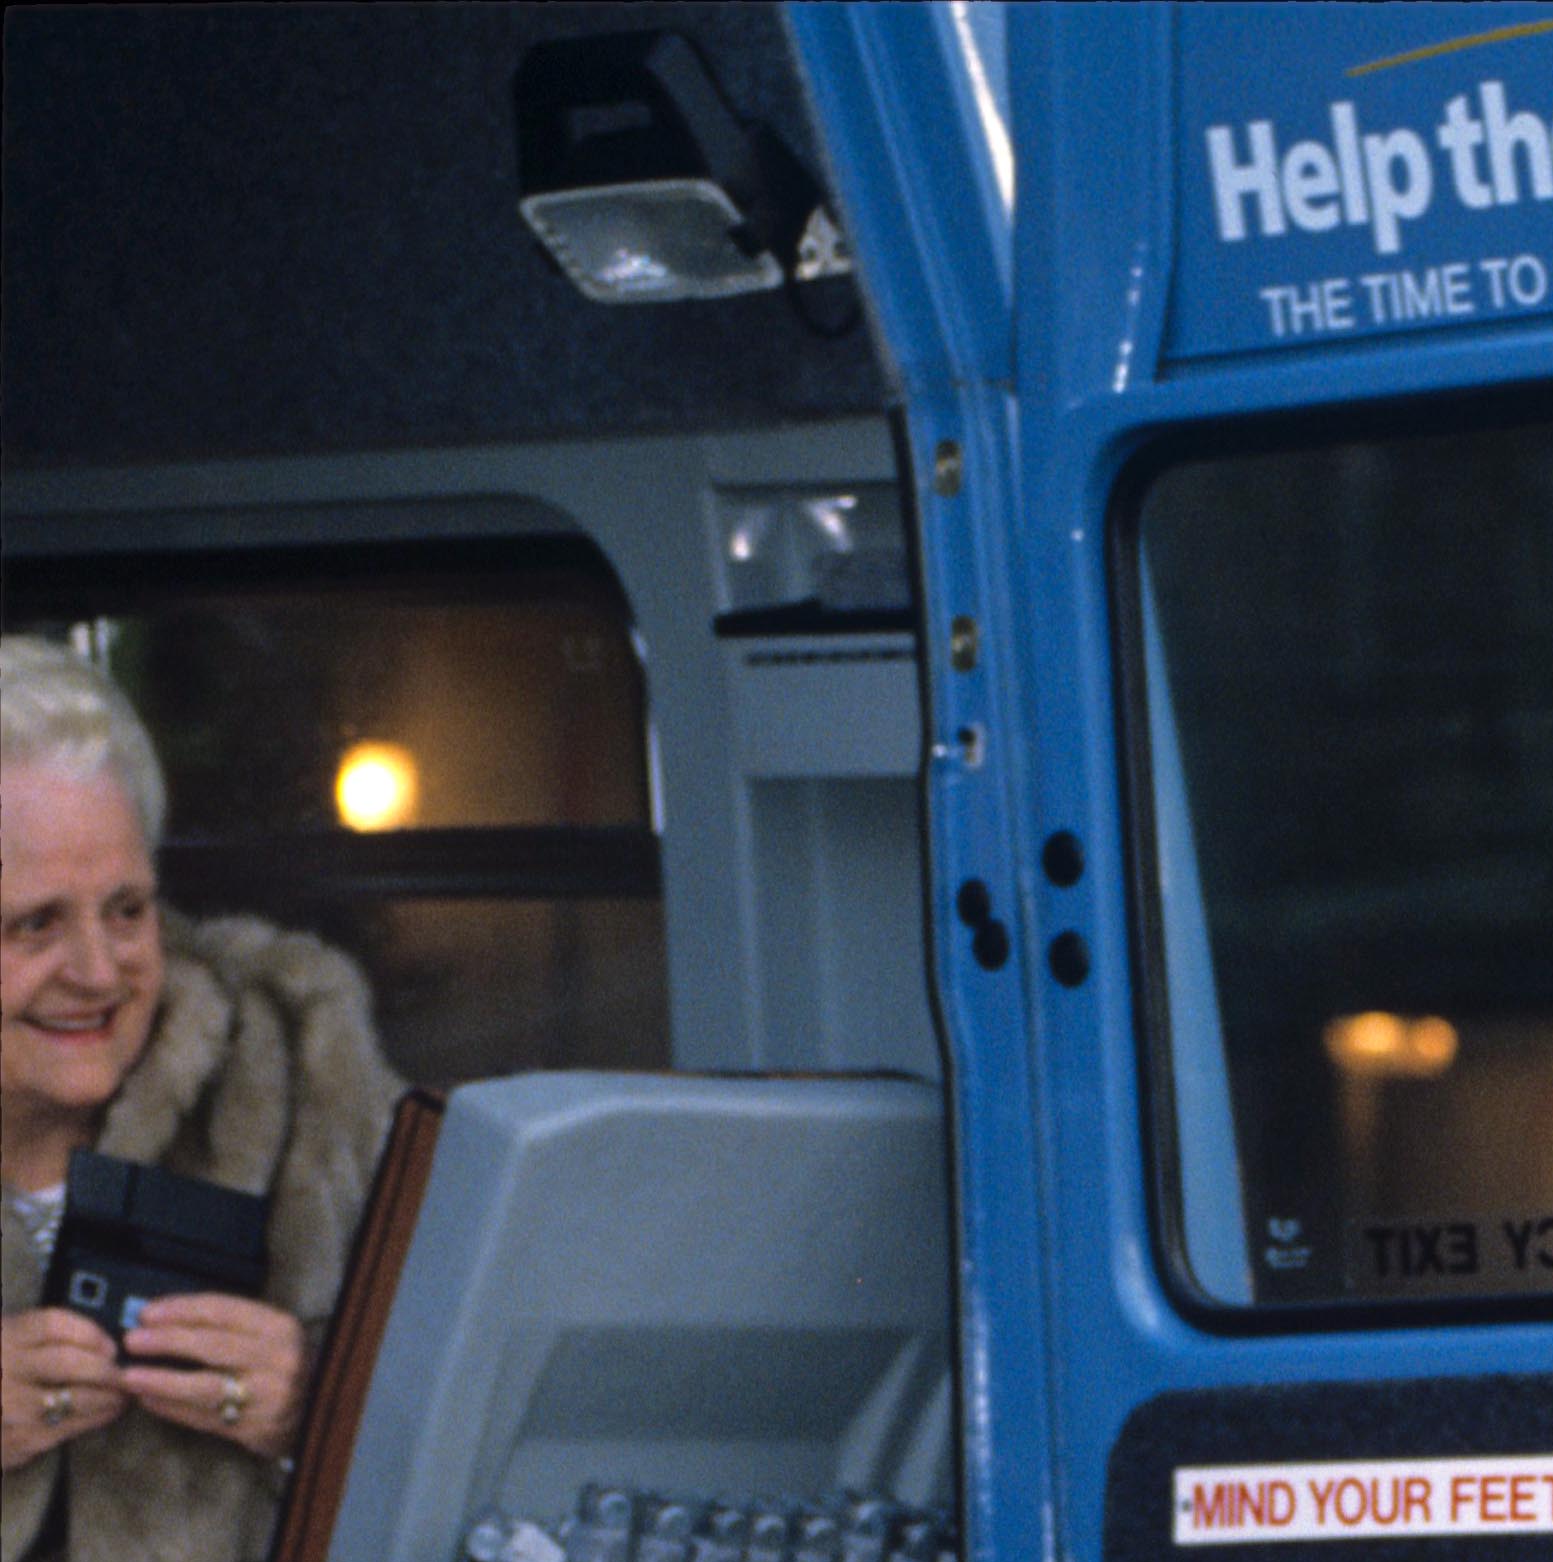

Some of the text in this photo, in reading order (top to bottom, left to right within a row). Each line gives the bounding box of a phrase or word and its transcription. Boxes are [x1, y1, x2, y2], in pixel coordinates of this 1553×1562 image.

[1205, 100, 1433, 254] Help
[1260, 277, 1355, 337] THE
[1360, 263, 1474, 322] TIME
[1480, 254, 1547, 308] TO
[1192, 1480, 1297, 1530] MIND
[1308, 1476, 1432, 1527] YOUR
